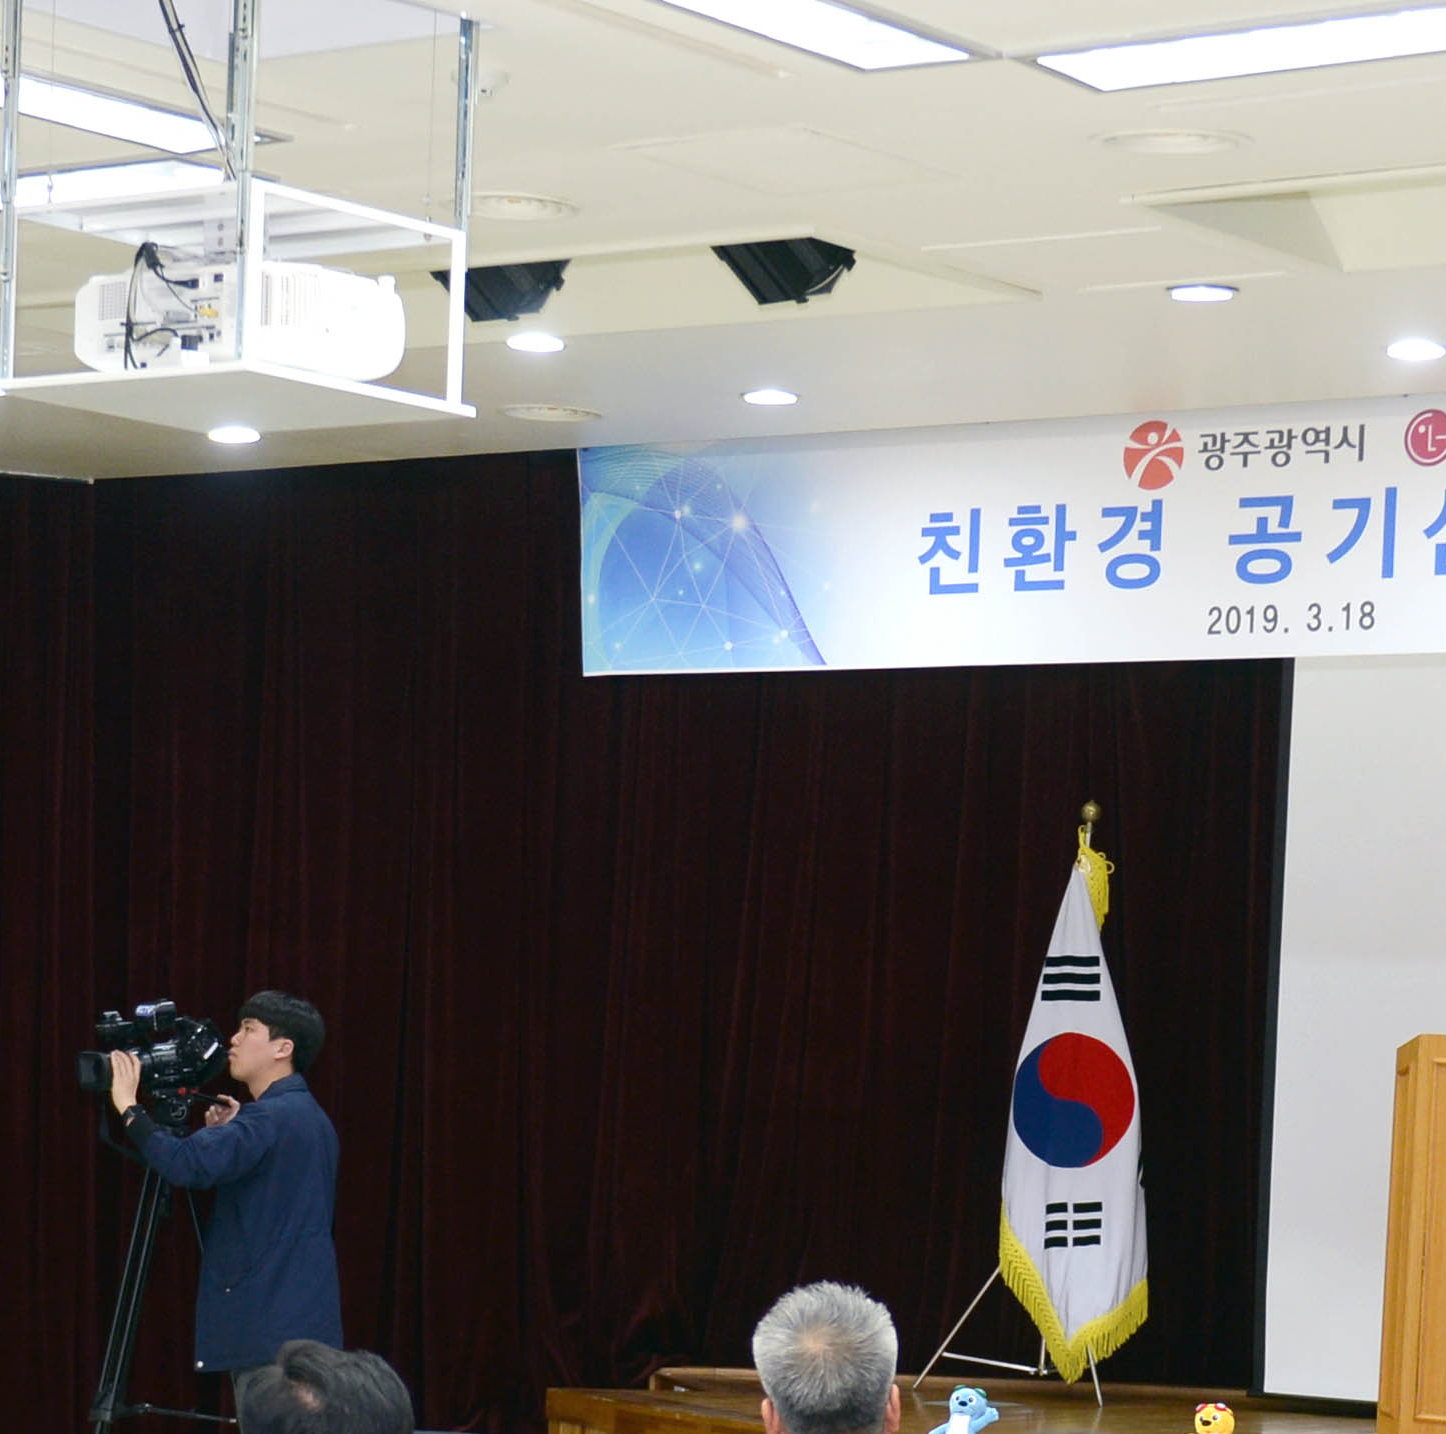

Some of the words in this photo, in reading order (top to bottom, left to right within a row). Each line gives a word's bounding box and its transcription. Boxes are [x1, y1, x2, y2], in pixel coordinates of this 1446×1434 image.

[1197, 423, 1366, 472] 광주광역시
[916, 497, 1166, 596] 친환경
[1206, 604, 1290, 636] 2019.
[1306, 600, 1377, 633] 3.18
